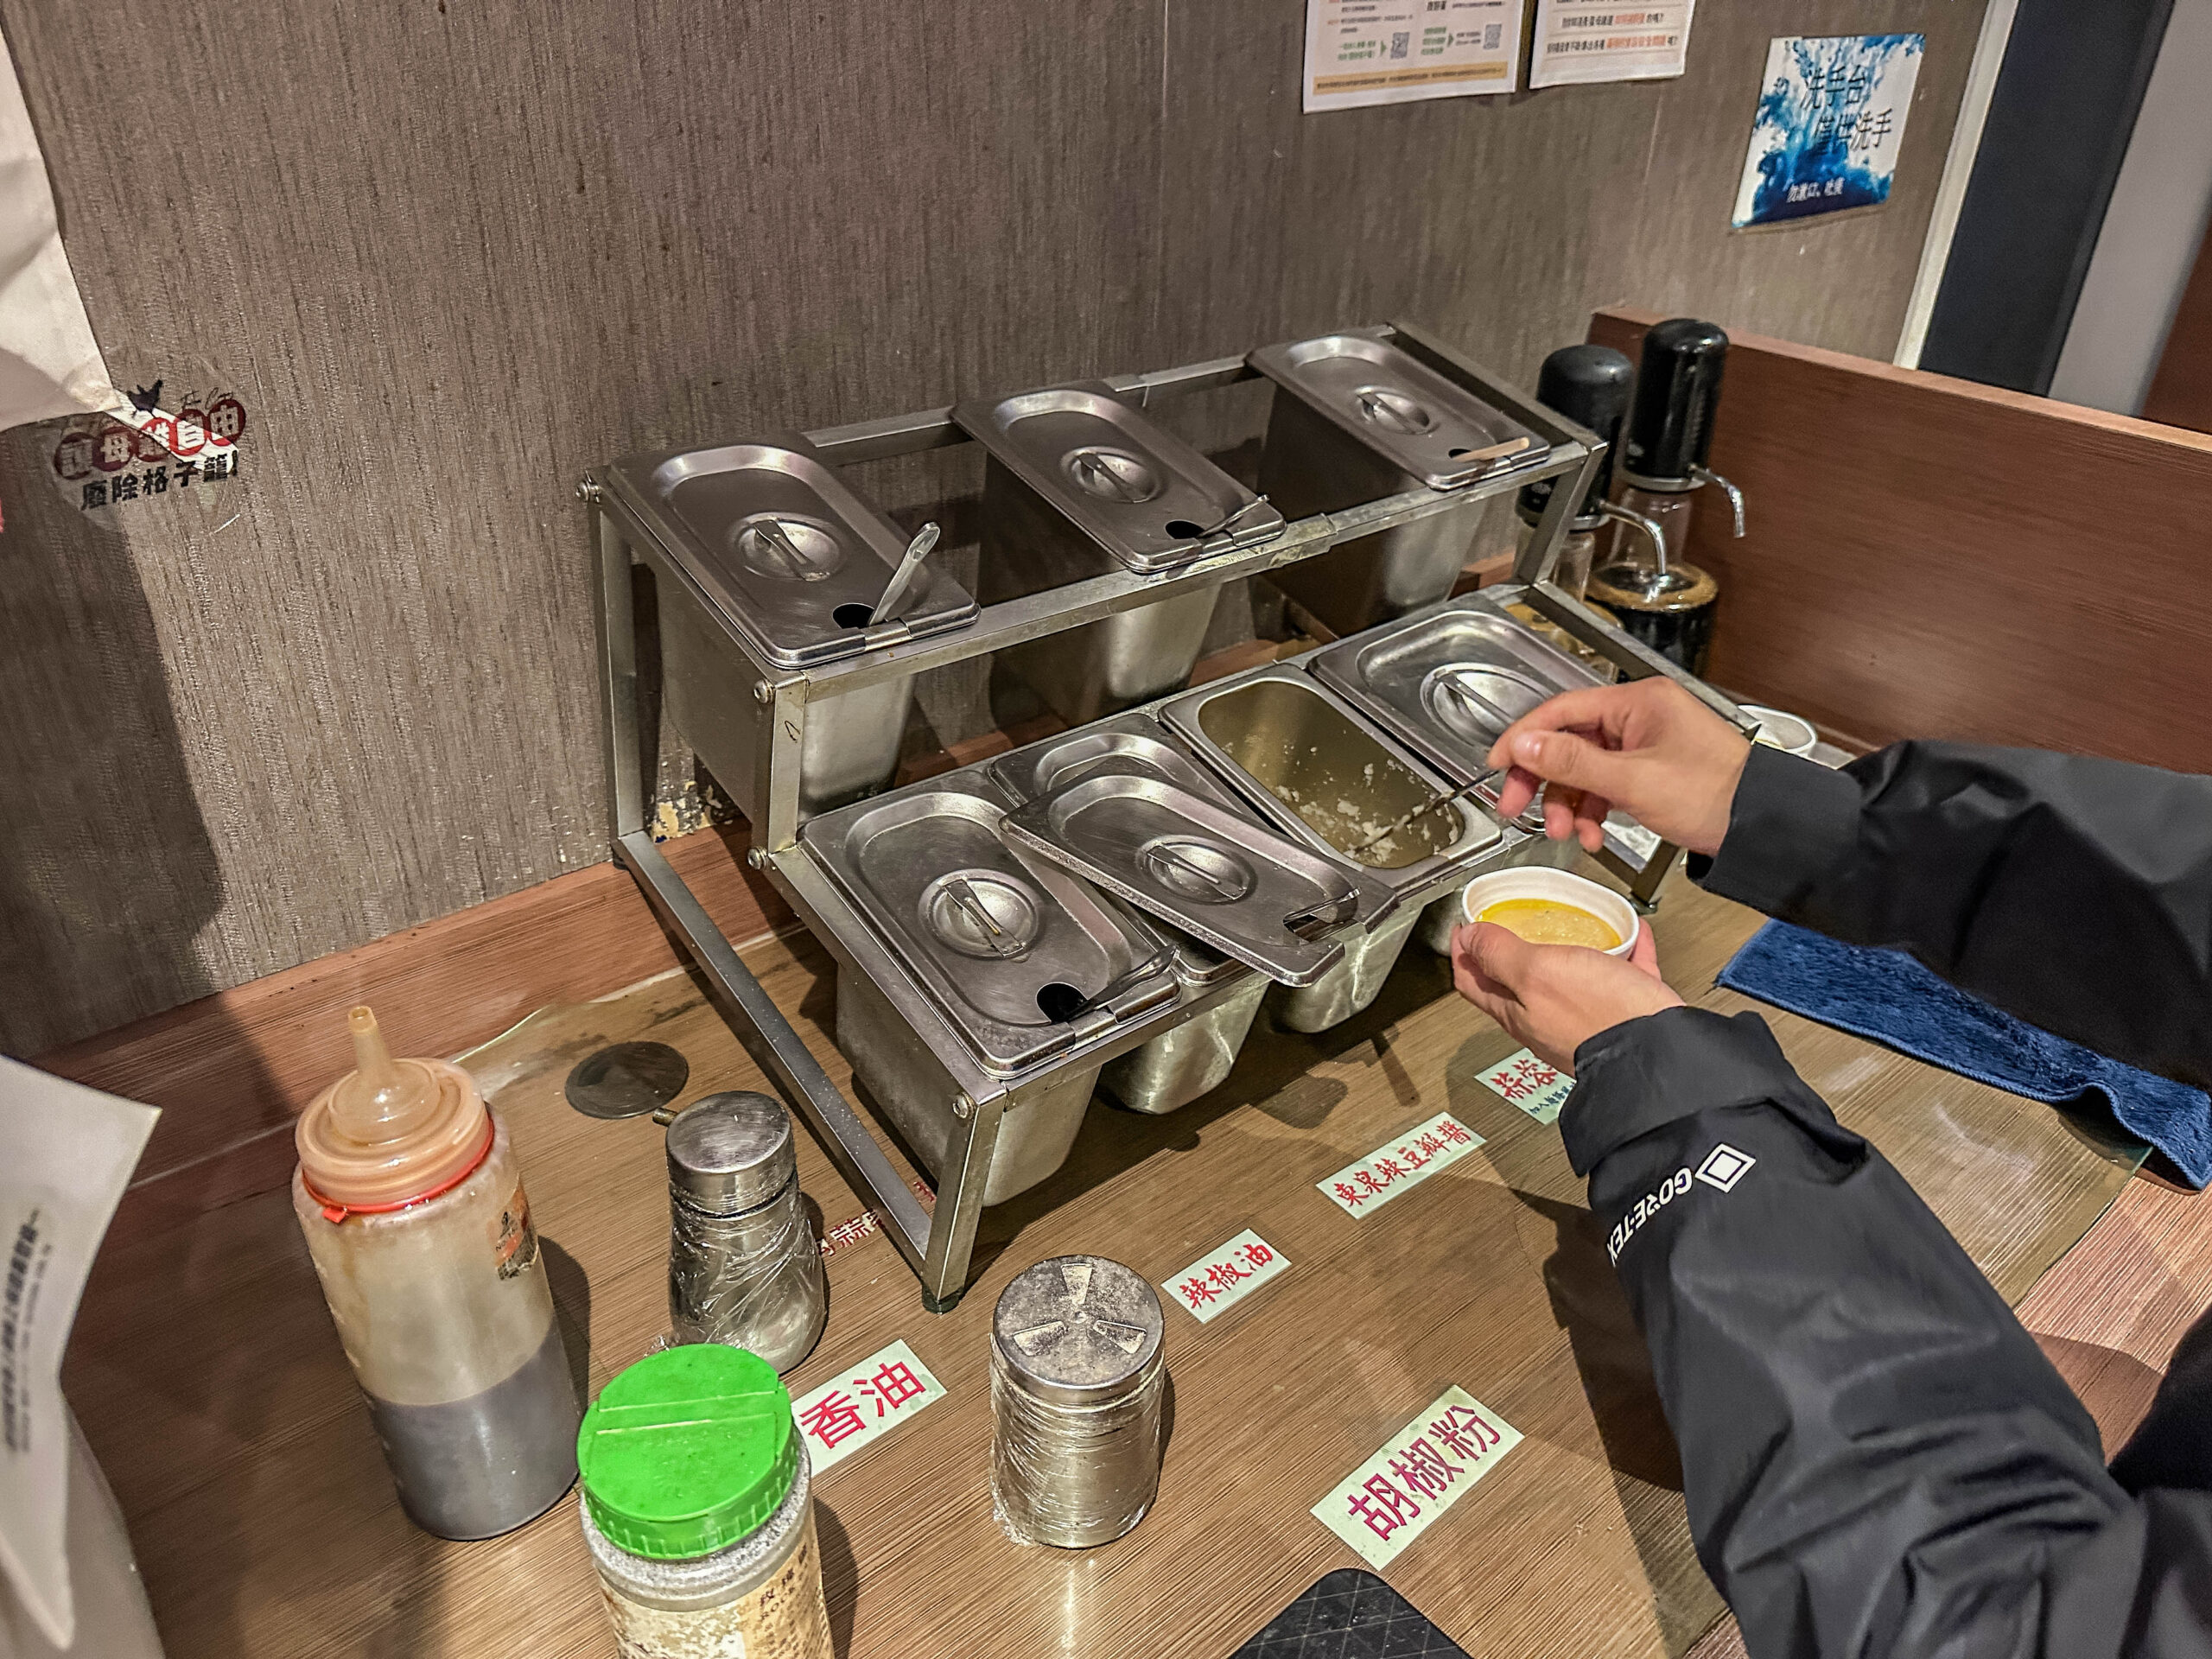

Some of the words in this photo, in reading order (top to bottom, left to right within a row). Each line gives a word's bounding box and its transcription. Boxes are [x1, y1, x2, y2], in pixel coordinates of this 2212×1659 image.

[1800, 65, 1866, 110] 洗手台
[1489, 1058, 1558, 1100] 蒜蓉
[1333, 1120, 1471, 1208] 東泉辣豆瓣醬
[1606, 1167, 1693, 1268] GORE-TEX
[1179, 1243, 1274, 1309] 辣椒油
[798, 1361, 927, 1450] 香油
[1346, 1395, 1501, 1541] 胡椒粉
